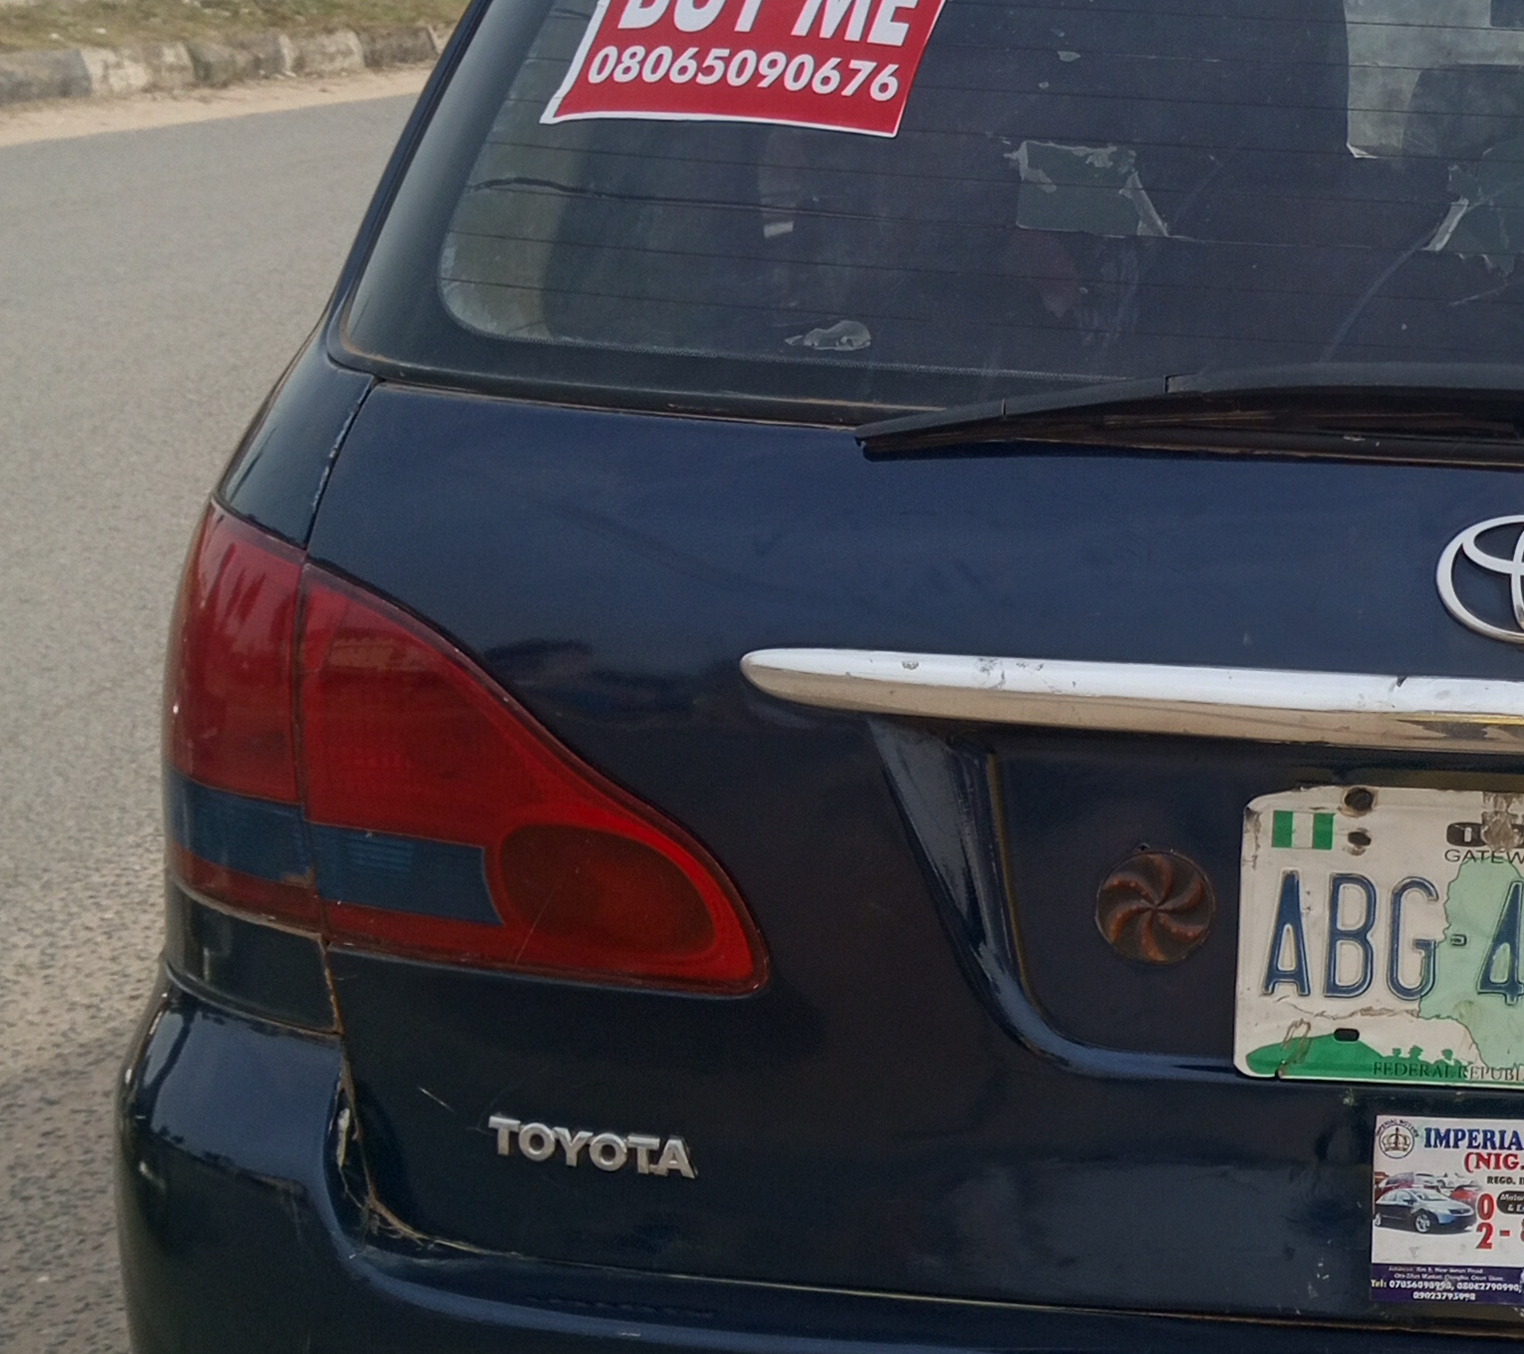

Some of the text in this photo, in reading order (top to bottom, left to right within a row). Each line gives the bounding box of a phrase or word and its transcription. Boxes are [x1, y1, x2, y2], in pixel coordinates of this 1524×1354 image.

[587, 45, 899, 102] 08065090676
[1373, 1060, 1452, 1079] FEDERAL
[488, 1114, 698, 1179] TOYOTA
